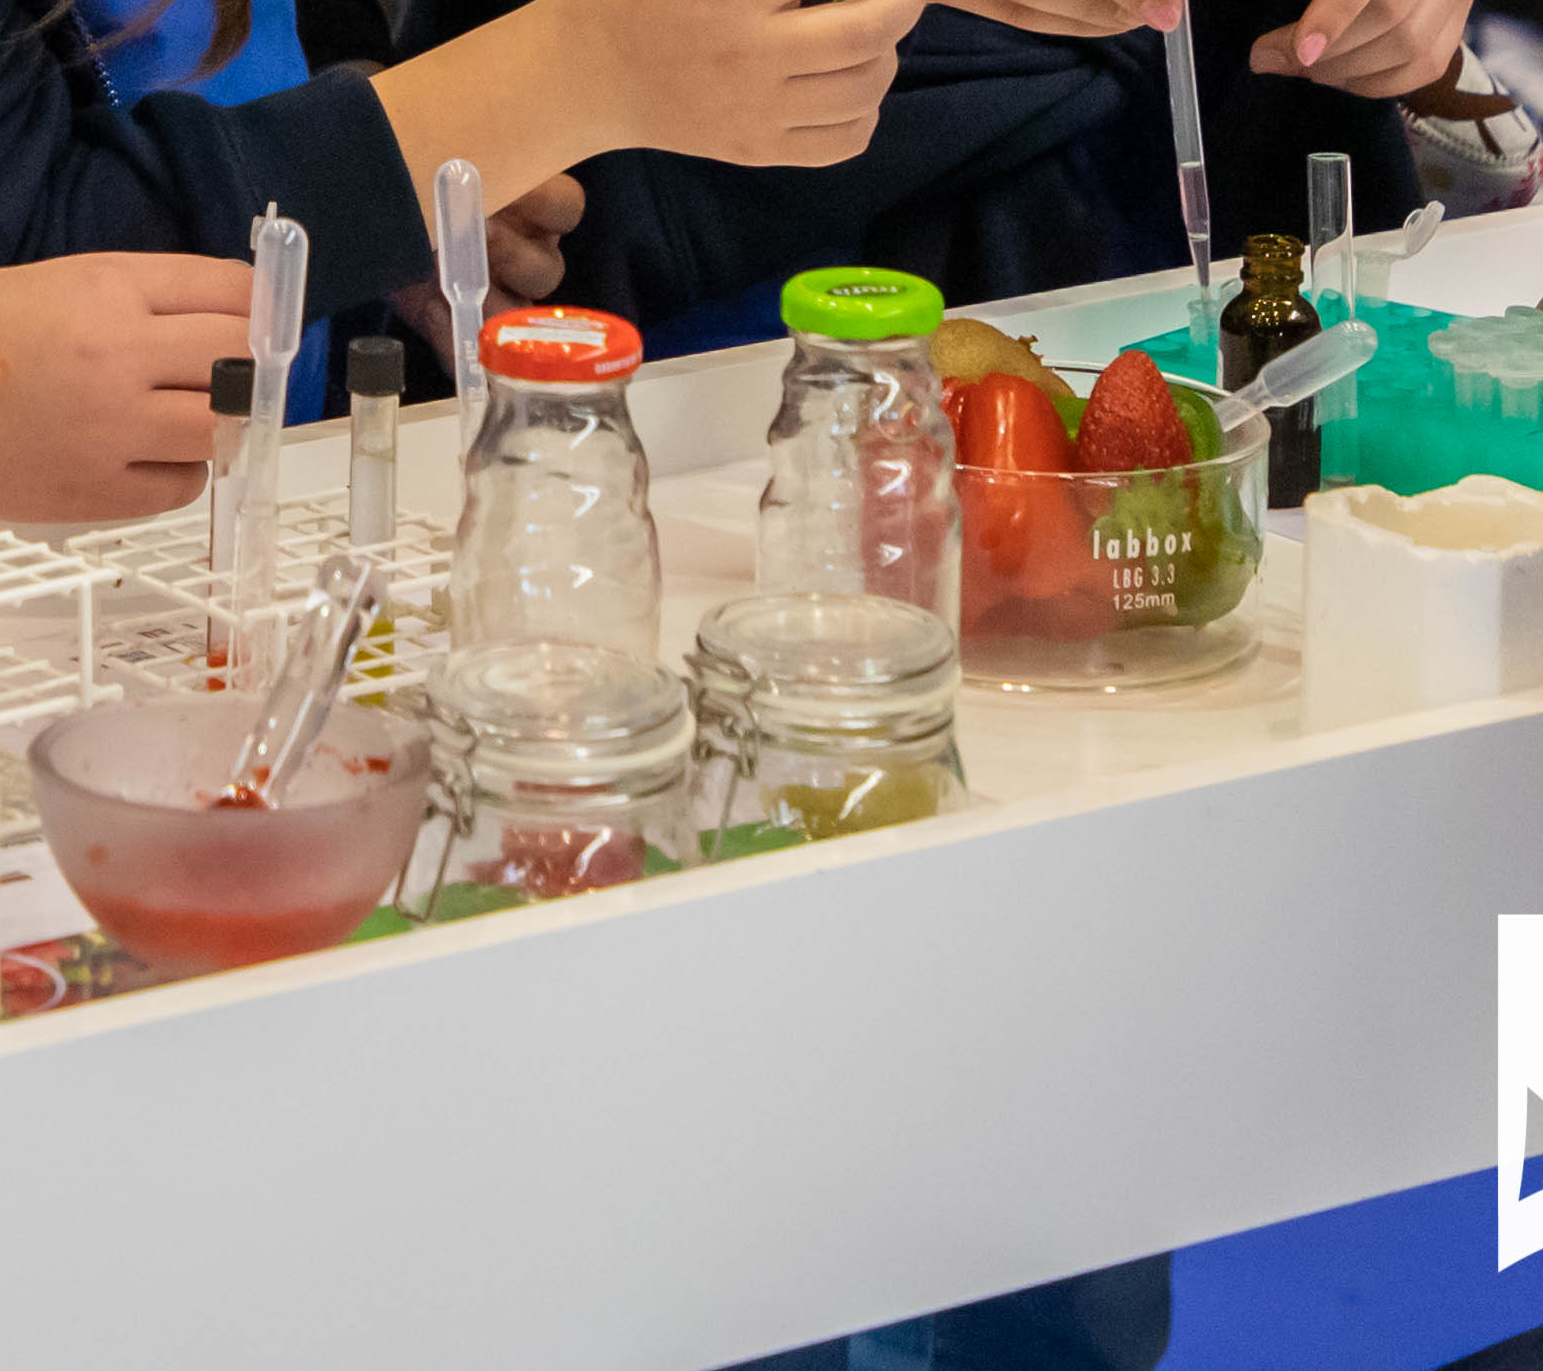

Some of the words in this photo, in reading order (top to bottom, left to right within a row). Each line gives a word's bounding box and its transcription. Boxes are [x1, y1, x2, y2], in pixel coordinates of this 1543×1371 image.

[1093, 527, 1192, 560] labbox
[1112, 566, 1144, 590] LBG
[1151, 562, 1176, 587] 3.3
[1112, 592, 1176, 611] 125mm
